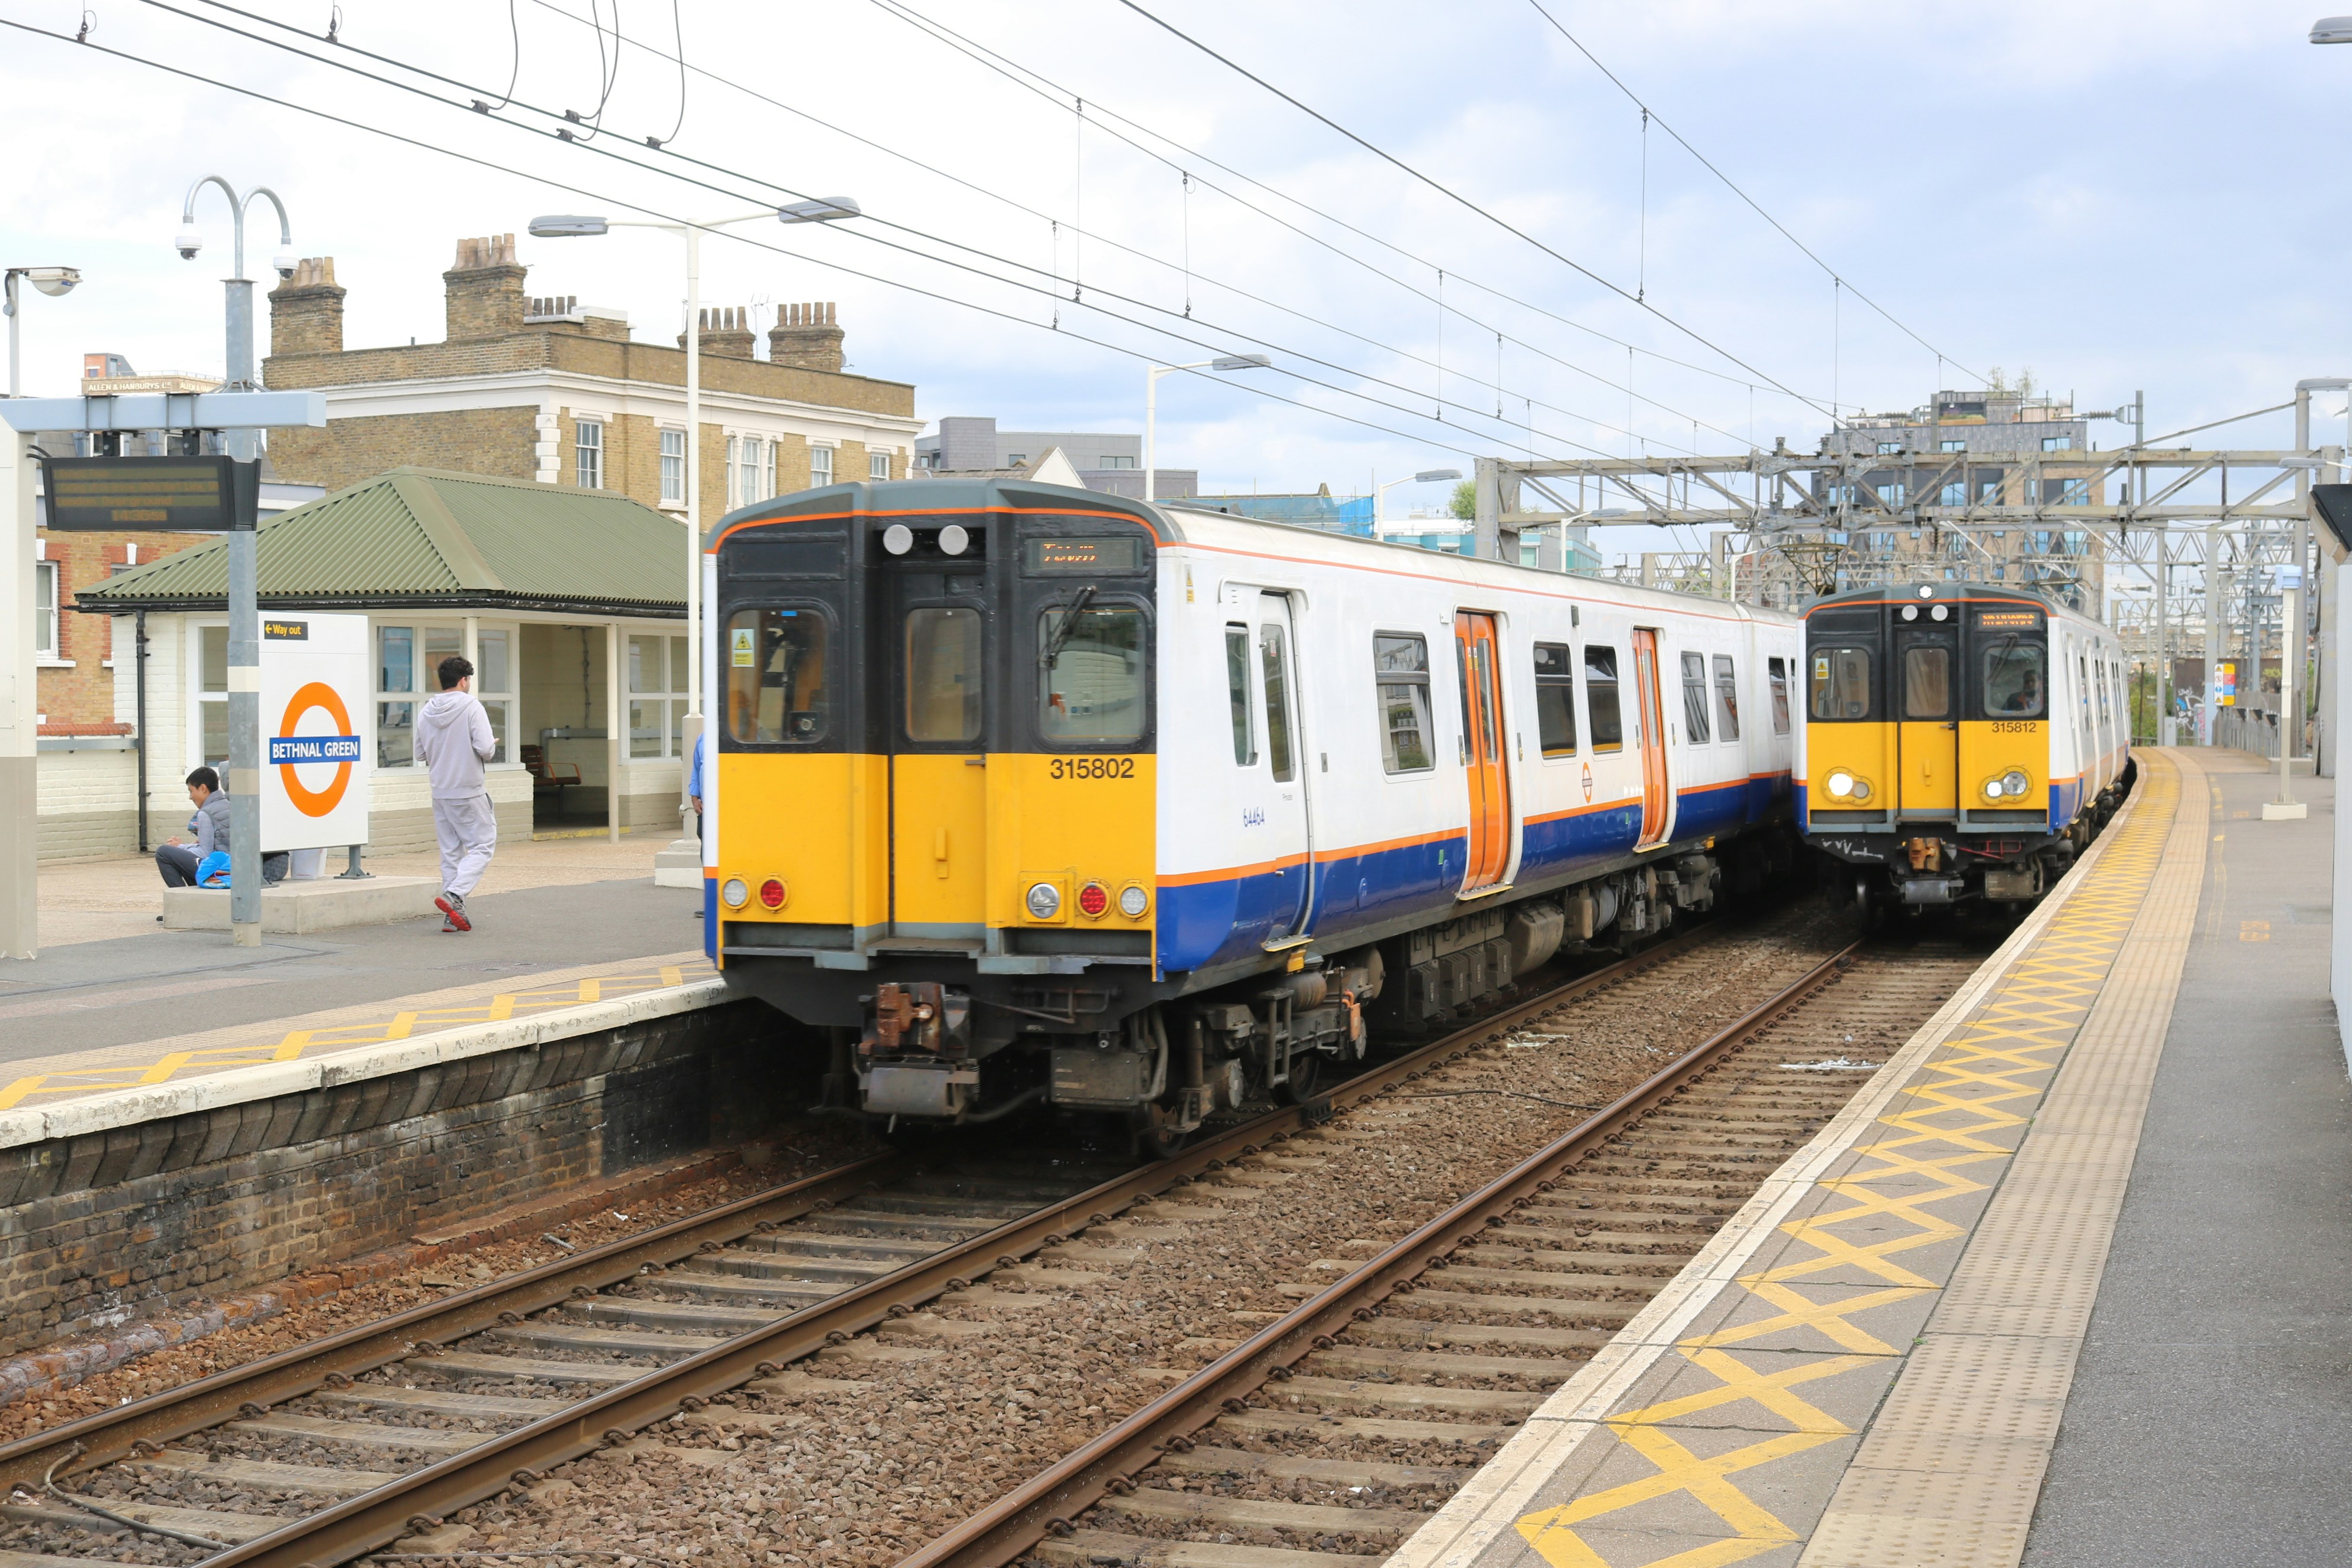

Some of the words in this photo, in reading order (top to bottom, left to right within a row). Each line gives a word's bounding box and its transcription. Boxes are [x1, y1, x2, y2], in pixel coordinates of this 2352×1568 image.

[273, 624, 288, 636] Way
[289, 626, 302, 635] out
[1992, 722, 2036, 733] 315812
[273, 742, 322, 758] BETHNAL
[325, 741, 358, 757] GREEN
[1050, 758, 1134, 779] 315802
[1243, 806, 1265, 827] 64464
